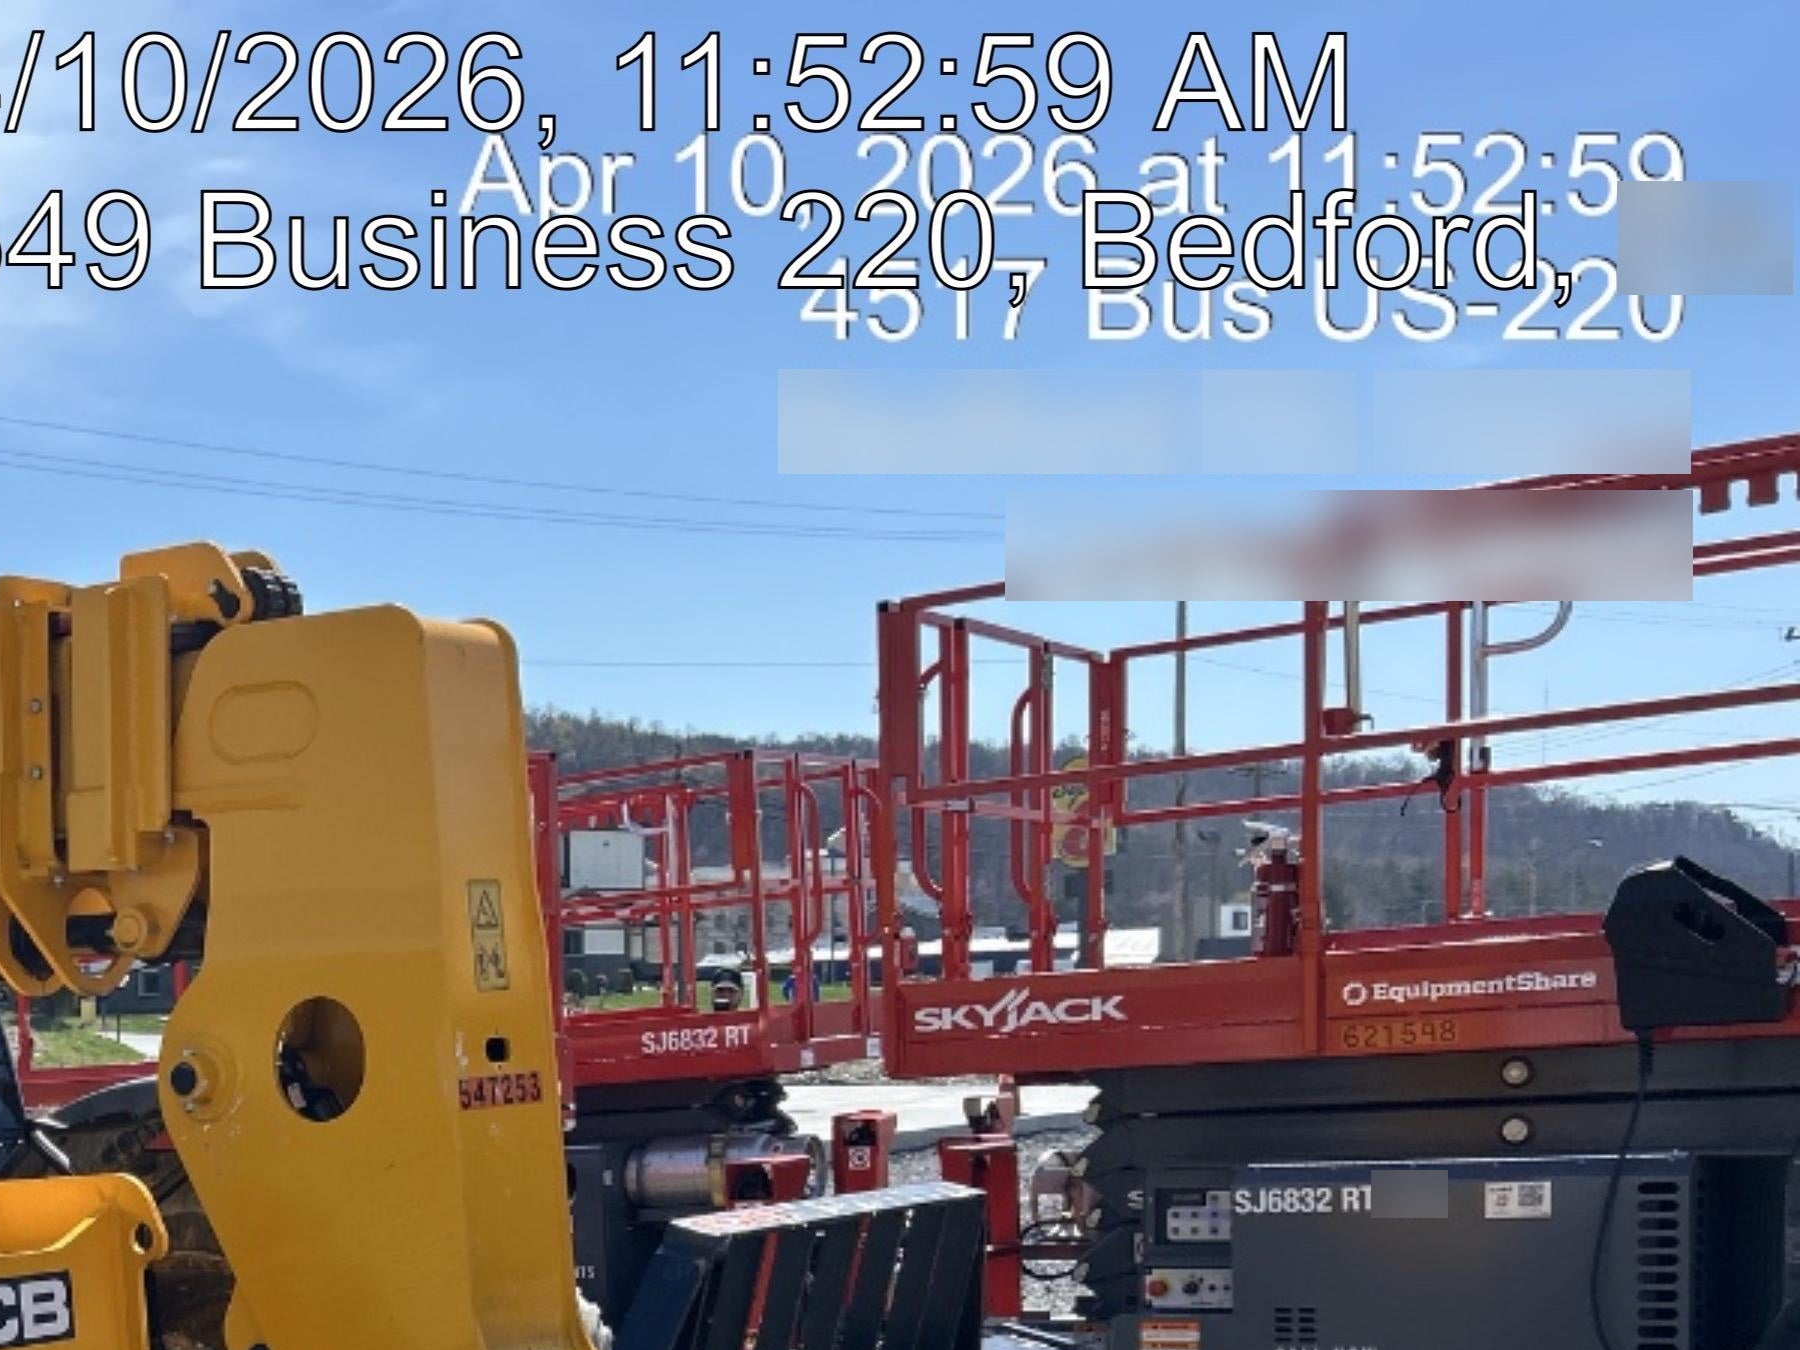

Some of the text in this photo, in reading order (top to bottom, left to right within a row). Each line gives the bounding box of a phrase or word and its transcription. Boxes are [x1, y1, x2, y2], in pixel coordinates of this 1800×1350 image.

[1372, 971, 1597, 1003] EquipmentShare
[914, 987, 1128, 1032] SKYJACK
[641, 1023, 751, 1054] SJ6832 RT
[458, 1071, 542, 1111] 547253
[1235, 1187, 1332, 1214] SJ6832
